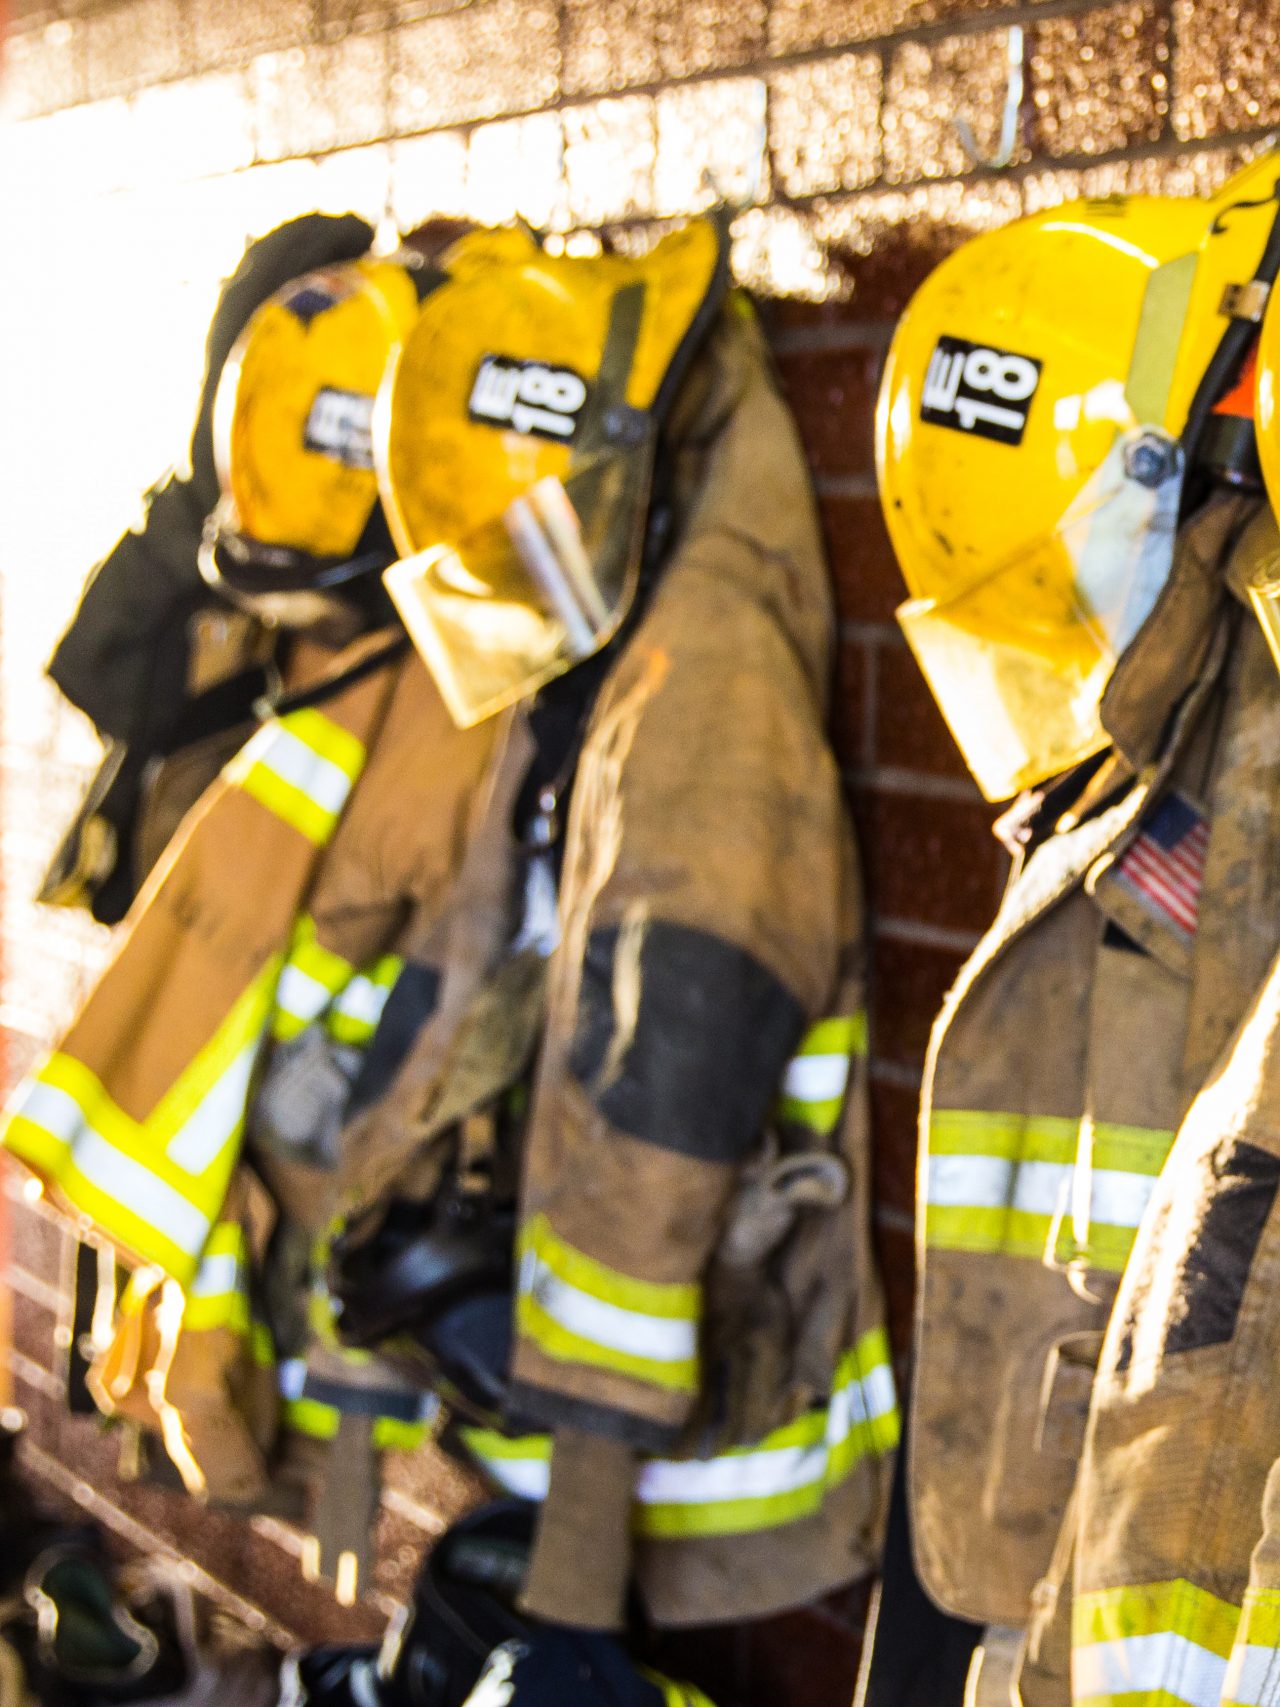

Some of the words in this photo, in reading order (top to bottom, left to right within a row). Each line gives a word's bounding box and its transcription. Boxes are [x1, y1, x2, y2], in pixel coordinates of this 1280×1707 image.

[511, 364, 587, 436] 18
[922, 348, 965, 413] E
[954, 349, 1038, 430] 18
